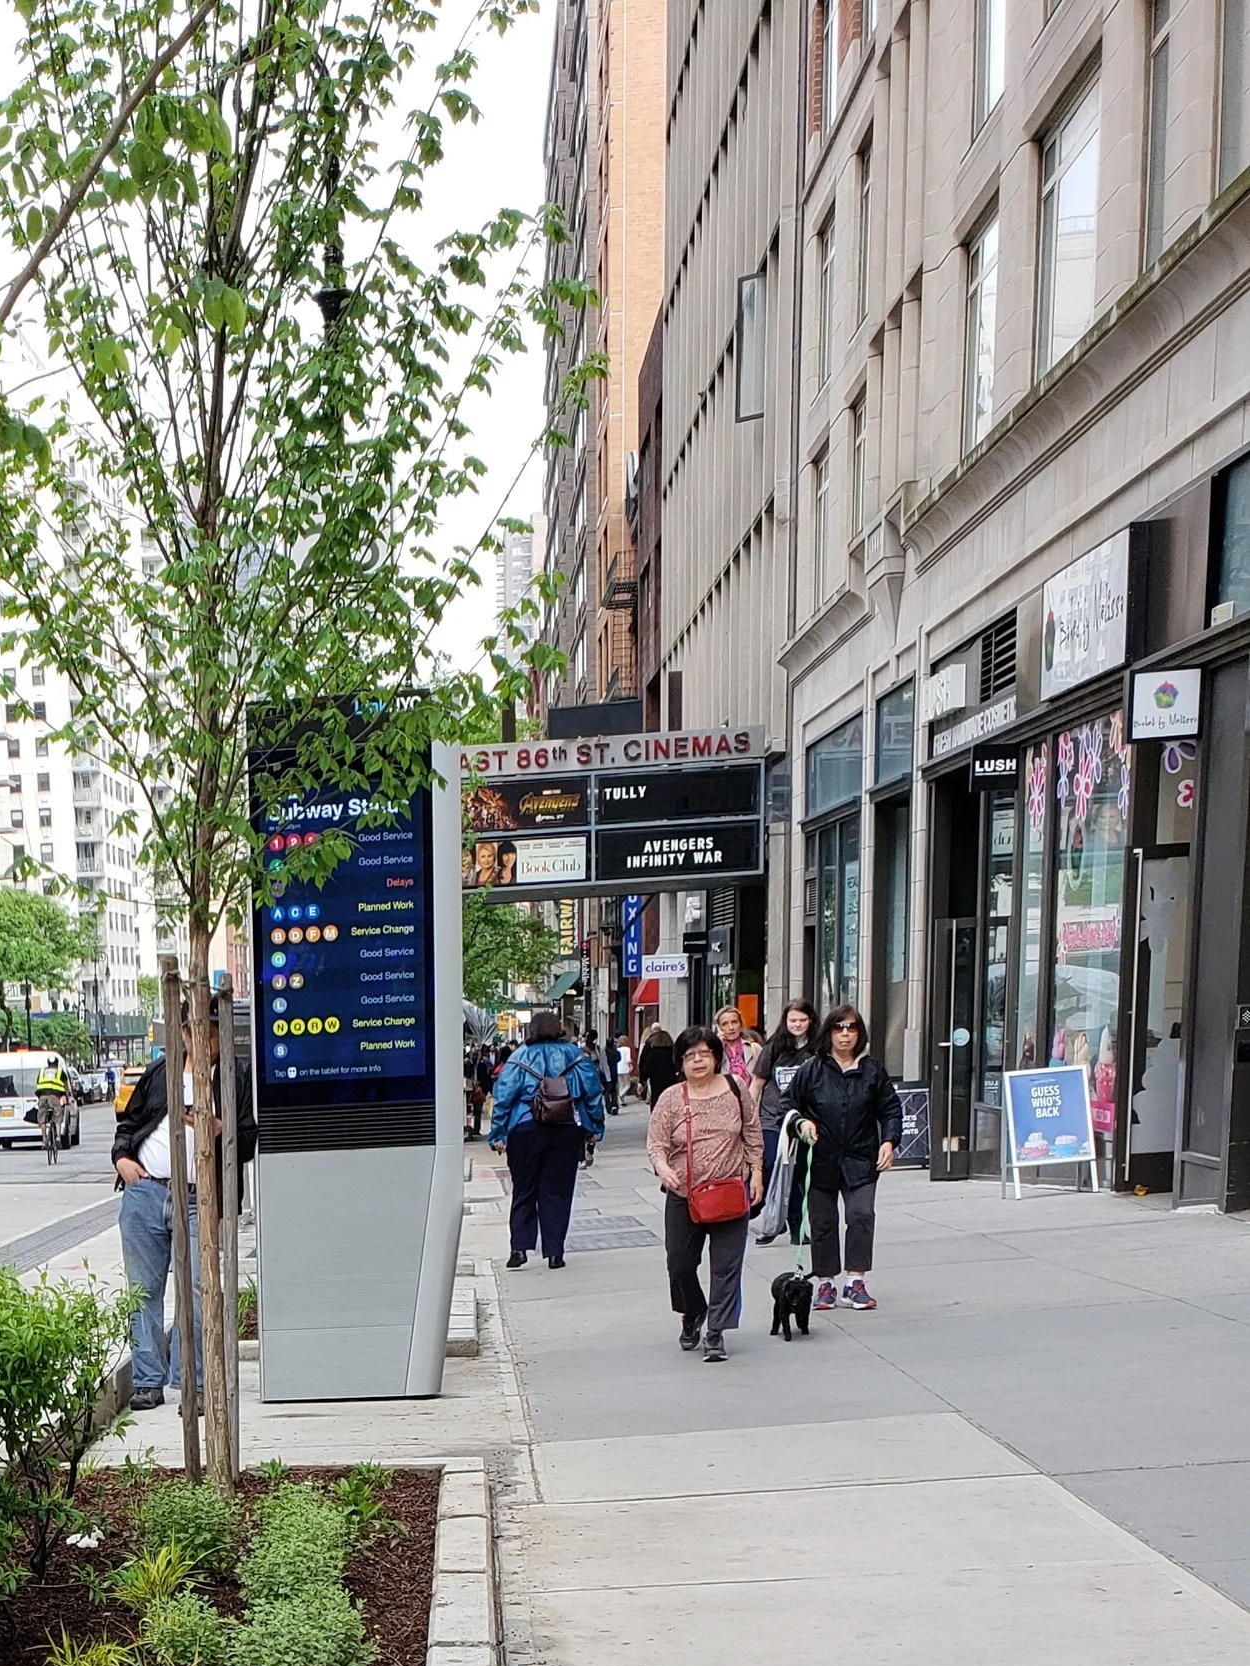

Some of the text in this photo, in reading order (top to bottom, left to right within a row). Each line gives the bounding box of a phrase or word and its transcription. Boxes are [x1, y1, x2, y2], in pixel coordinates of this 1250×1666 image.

[1158, 716, 1166, 730] by
[460, 731, 751, 772] AST 86th ST. CINEMAS
[975, 759, 1017, 772] LUSH
[604, 785, 647, 800] TULLY
[358, 831, 413, 842] Good Service
[644, 836, 714, 853] AVENGERS
[358, 855, 413, 866] Good Service
[626, 850, 723, 868] INFINITY WAR
[521, 858, 581, 874] Book Club
[386, 878, 414, 888] Delays
[358, 900, 414, 911] Planned Work
[351, 925, 414, 936] Service Change
[360, 947, 414, 958] Good Service
[645, 961, 685, 973] claire's
[360, 971, 415, 981] Good Service
[361, 994, 415, 1004] Good Service
[352, 1016, 415, 1028] Service Change
[360, 1038, 415, 1050] Planned Work
[275, 1069, 286, 1078] Tap
[309, 1067, 320, 1075] the
[321, 1066, 339, 1075] tablet
[340, 1065, 349, 1074] for
[369, 1064, 381, 1072] info
[1031, 1085, 1060, 1097] GUESS
[1031, 1095, 1062, 1108] WHO'S
[1035, 1106, 1060, 1119] BACK
